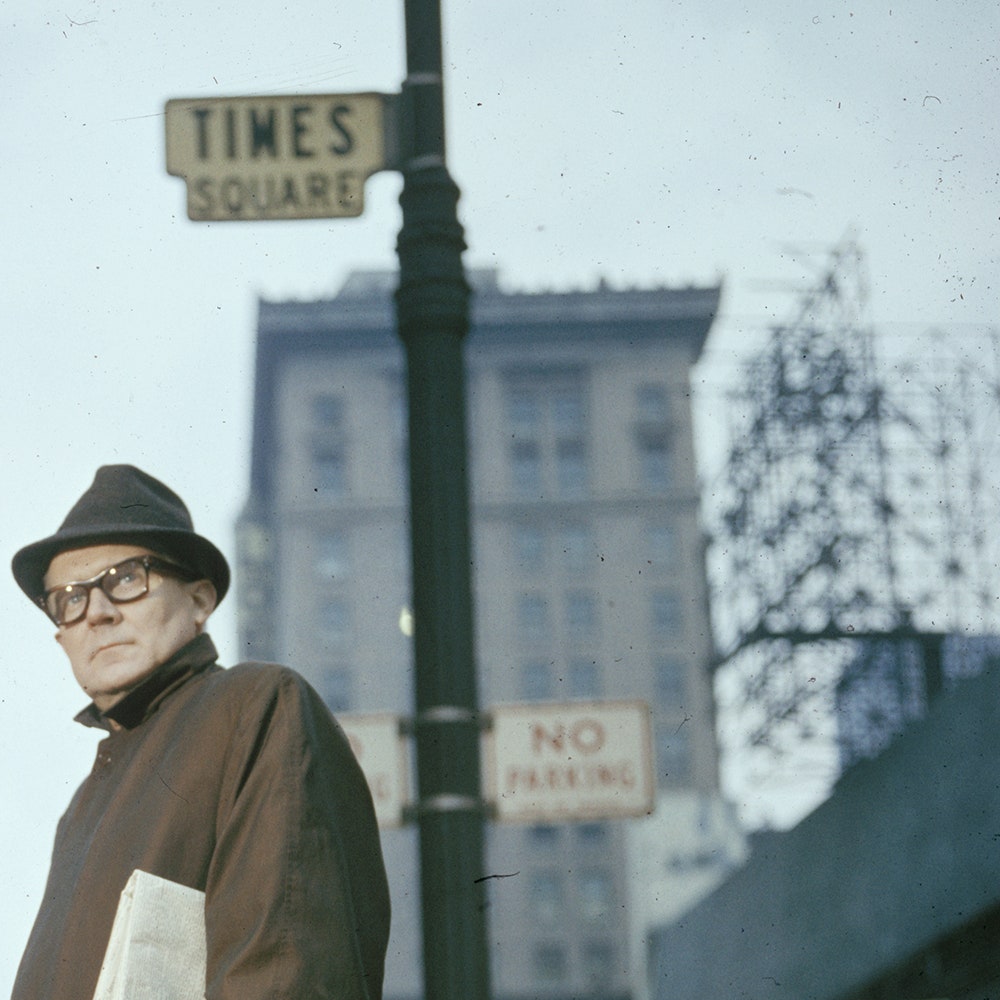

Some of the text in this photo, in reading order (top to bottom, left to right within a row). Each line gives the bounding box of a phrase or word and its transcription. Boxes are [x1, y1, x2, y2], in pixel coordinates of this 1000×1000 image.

[192, 104, 357, 159] TIMES
[192, 172, 360, 213] SQUARE
[529, 719, 605, 753] NO
[504, 760, 637, 793] PARKING
